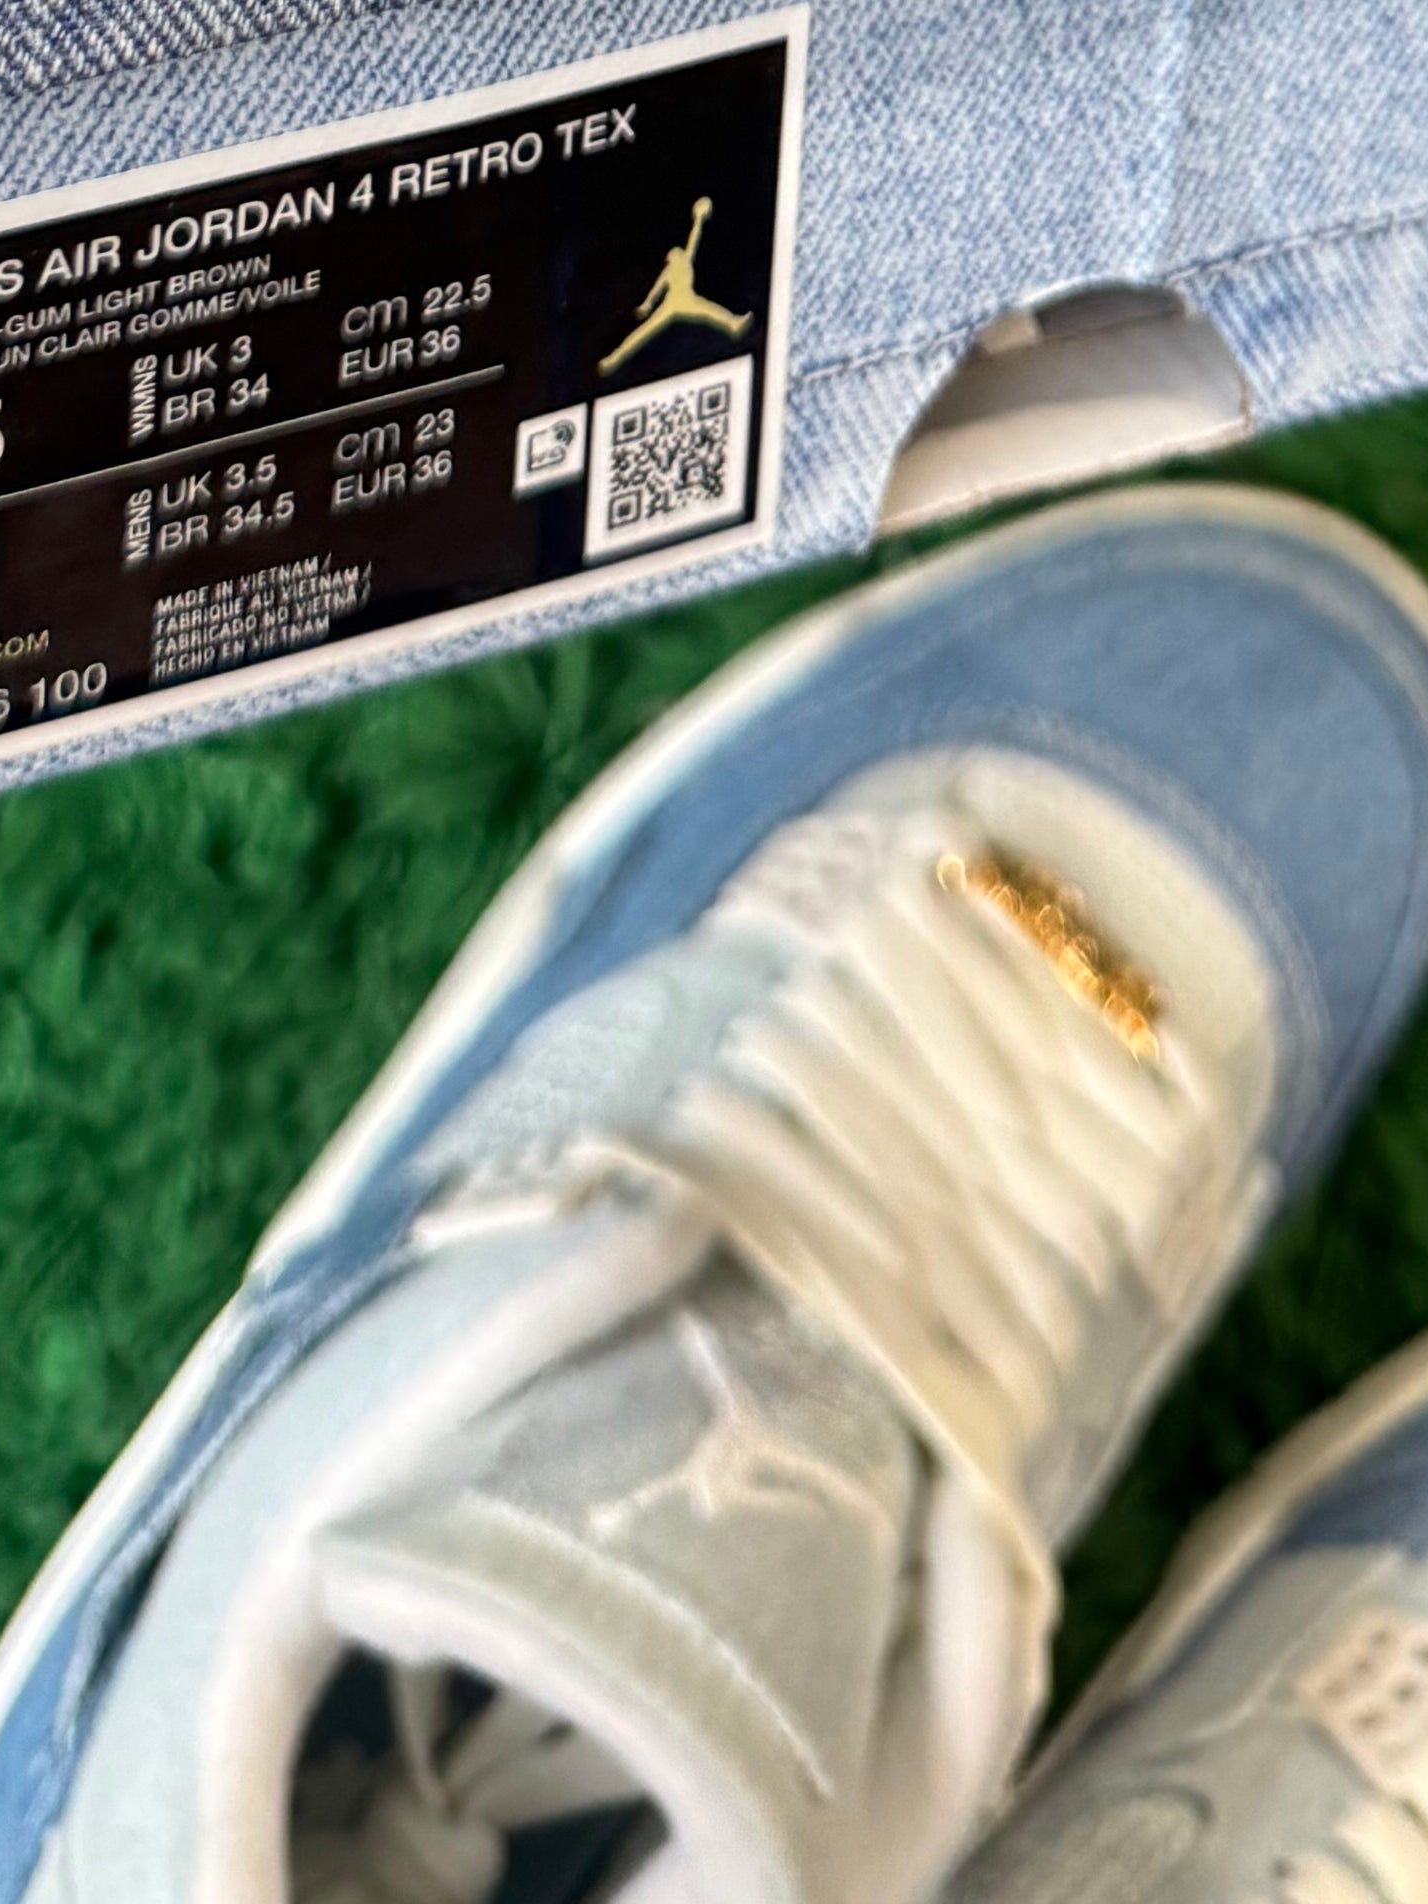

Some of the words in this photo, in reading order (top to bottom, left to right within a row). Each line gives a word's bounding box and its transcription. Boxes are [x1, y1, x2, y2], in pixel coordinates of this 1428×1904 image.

[38, 235, 121, 290] AIR
[134, 182, 335, 265] JORDAN
[348, 173, 374, 210] 4
[390, 132, 543, 205] RETRO
[555, 103, 637, 160] TEX
[38, 320, 121, 359] CLAIR
[128, 269, 321, 340] GOMME/VOILE
[79, 279, 161, 321] LIGHT
[170, 253, 272, 298] BROWN
[340, 296, 408, 343] cm
[422, 274, 492, 324] 22.5
[162, 343, 219, 385] UK
[228, 335, 253, 370] 3
[338, 338, 414, 387] EUR
[418, 325, 461, 366] 36
[129, 354, 158, 447] WMNS
[161, 387, 215, 433] BR
[226, 373, 271, 414] 34
[333, 422, 401, 470] cm
[413, 408, 455, 450] 23
[157, 471, 212, 515] UK
[222, 455, 277, 498] 3.5
[332, 463, 407, 515] EUR
[411, 450, 453, 489] 36
[123, 488, 152, 570] MENS
[156, 515, 209, 560] BR
[221, 492, 295, 543] 34.5
[155, 586, 209, 613] MADE
[215, 581, 234, 598] IN
[249, 591, 274, 608] AU
[152, 647, 215, 678] HECHO
[222, 640, 245, 660] EN
[252, 614, 329, 650] VIETNAM
[153, 616, 256, 656] FABRICADO
[261, 607, 288, 625] NO
[30, 662, 107, 718] 100
